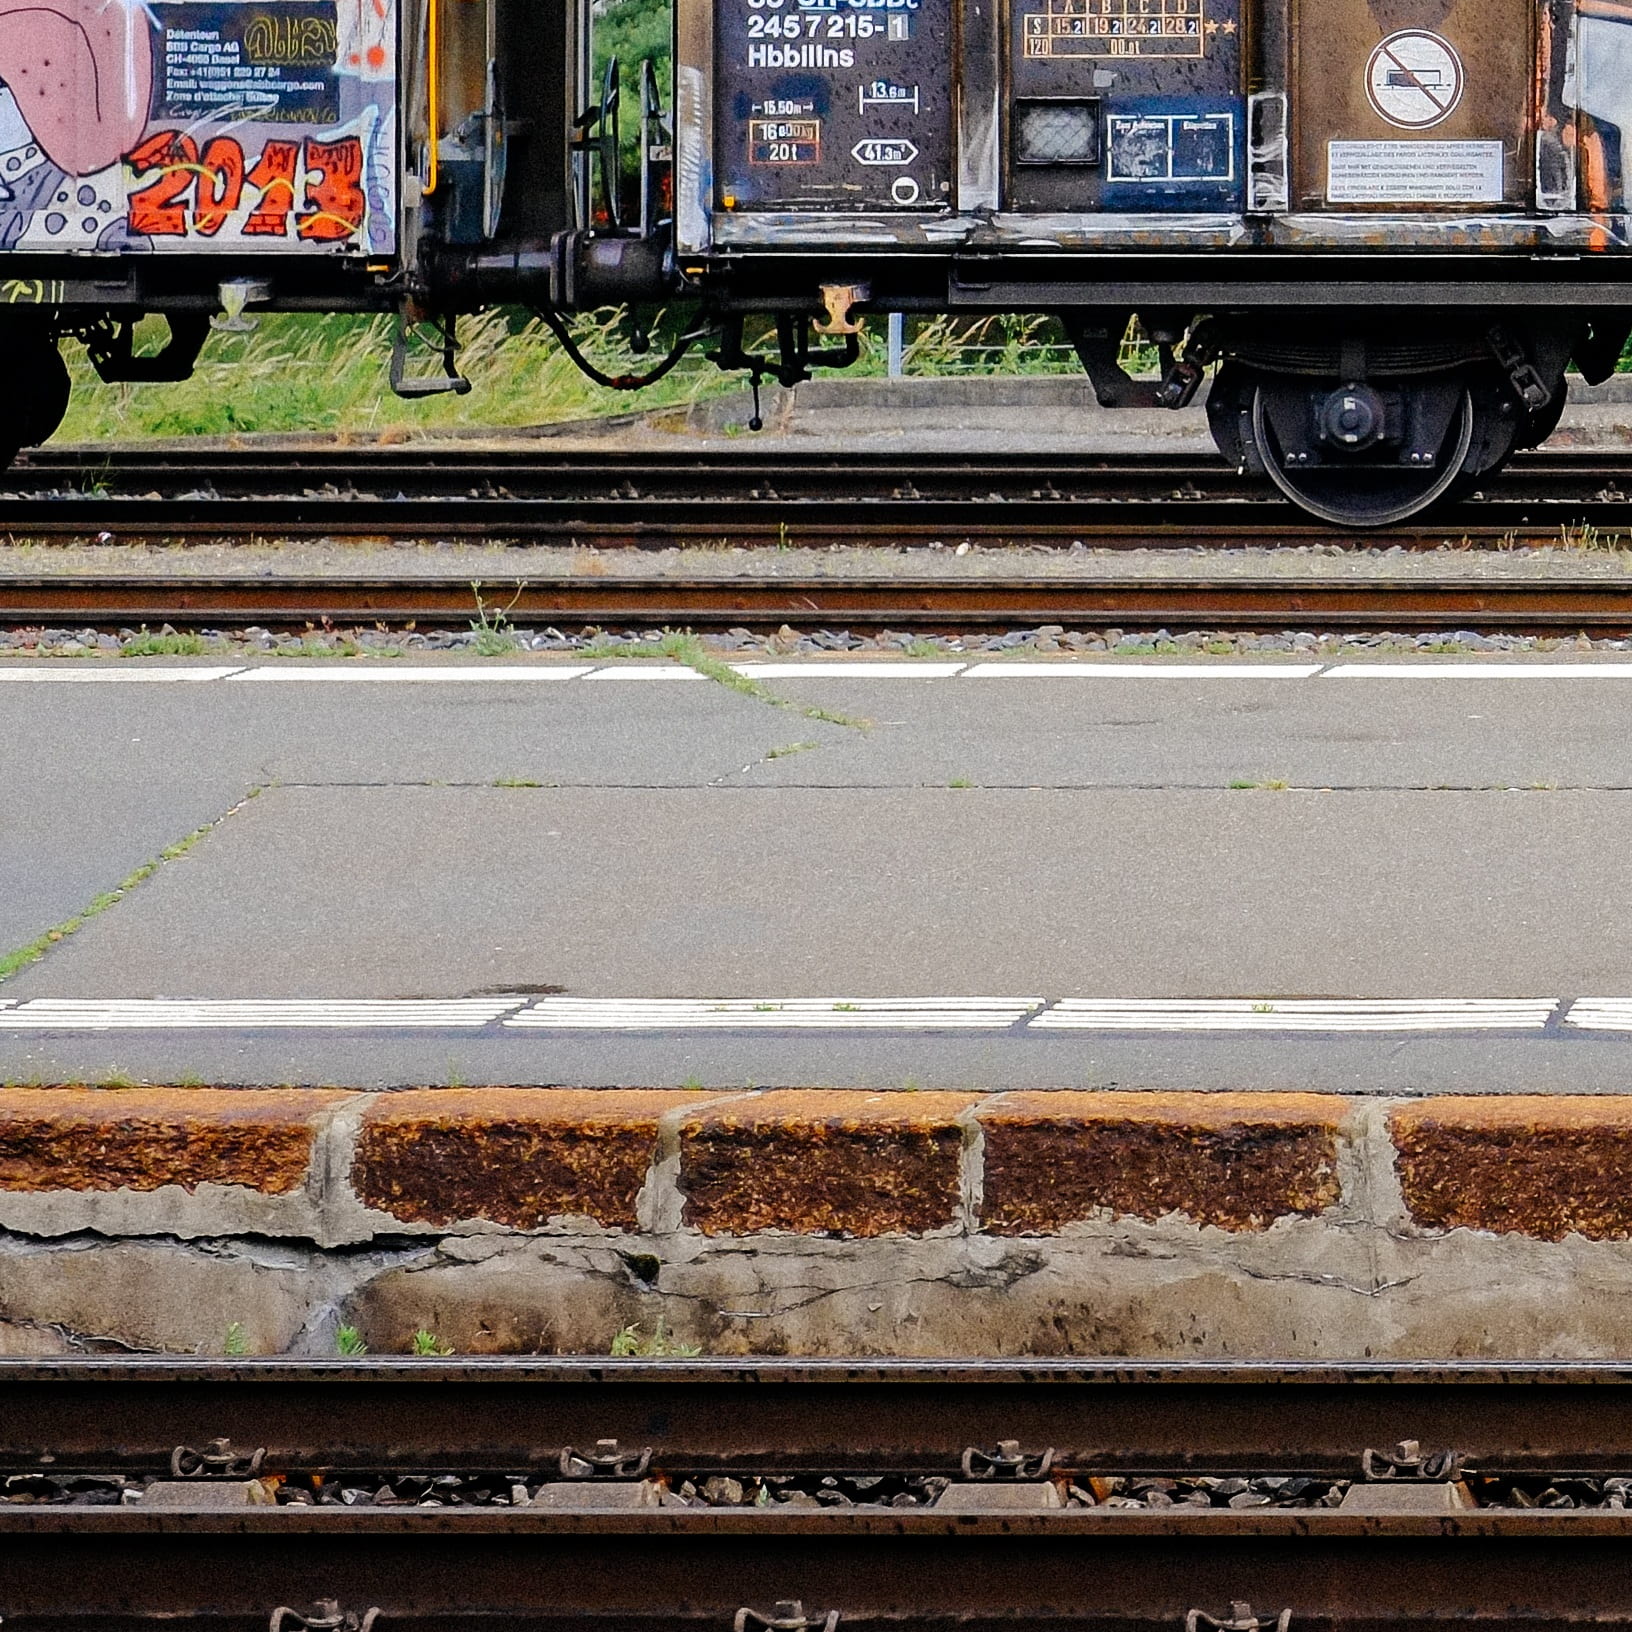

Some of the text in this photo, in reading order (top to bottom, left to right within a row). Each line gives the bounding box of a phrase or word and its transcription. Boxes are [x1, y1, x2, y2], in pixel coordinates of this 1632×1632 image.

[1033, 19, 1042, 34] S
[190, 42, 221, 54] Cargo
[223, 42, 240, 52] AG
[1029, 39, 1048, 55] 120
[122, 129, 364, 244] 2013
